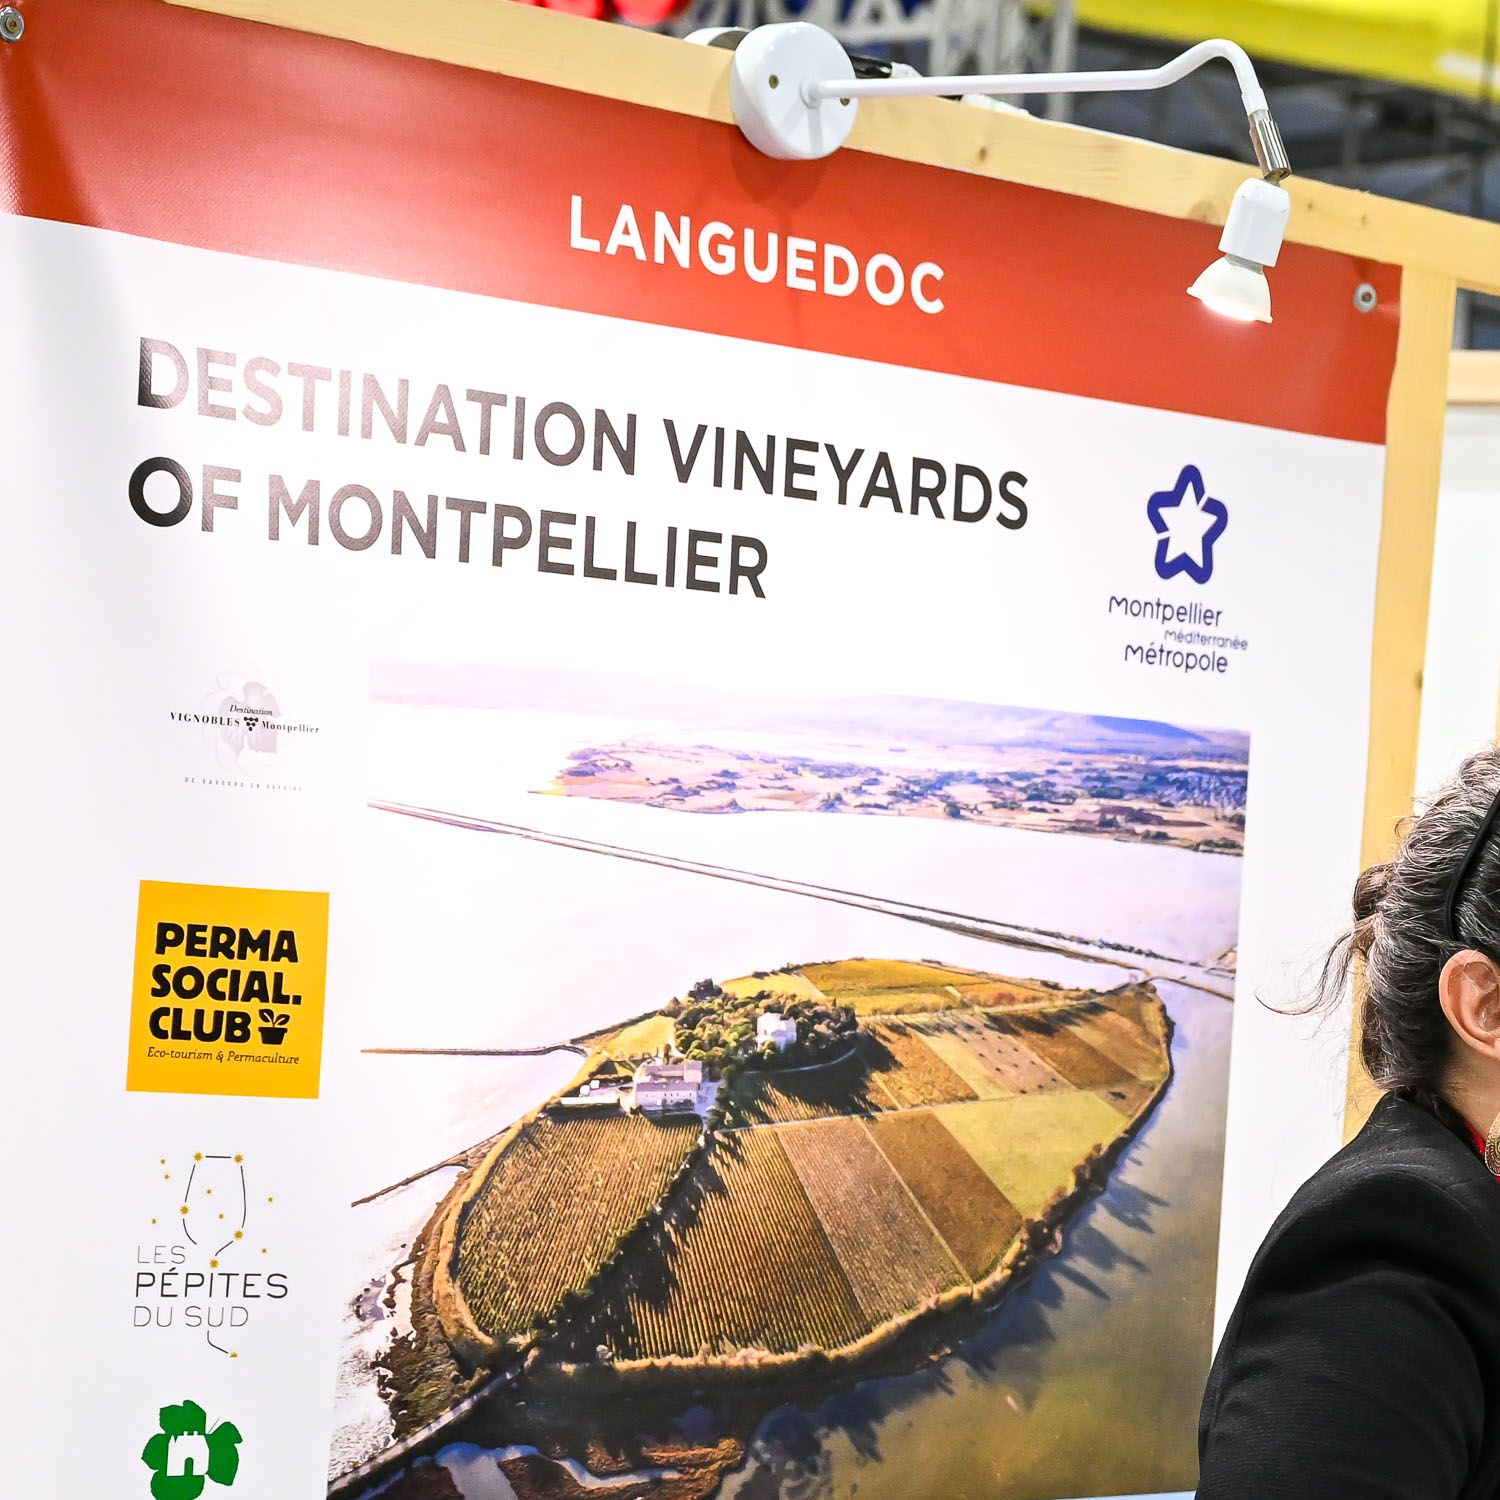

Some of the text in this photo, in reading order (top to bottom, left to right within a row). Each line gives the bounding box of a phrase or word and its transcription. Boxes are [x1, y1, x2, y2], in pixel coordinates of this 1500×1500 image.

[569, 195, 946, 315] LANGUEDOC
[137, 337, 1029, 531] DESTINATION VINEYARDS
[128, 456, 768, 600] OF MONTPELLIER
[1108, 595, 1223, 627] Montpellier
[1164, 629, 1249, 651] Méditerranée
[1124, 642, 1229, 673] Métropole
[169, 711, 320, 734] VIGNOBLES Montpellier
[229, 704, 273, 716] Destination
[154, 921, 299, 963] PERMA
[150, 963, 303, 1006] SOCIAL.
[148, 1006, 252, 1044] CLUB
[147, 1046, 300, 1065] Eco-tourism & Permaculture
[136, 1244, 187, 1264] LES
[134, 1267, 289, 1299] PÉPITES
[132, 1305, 249, 1328] DU SUD
